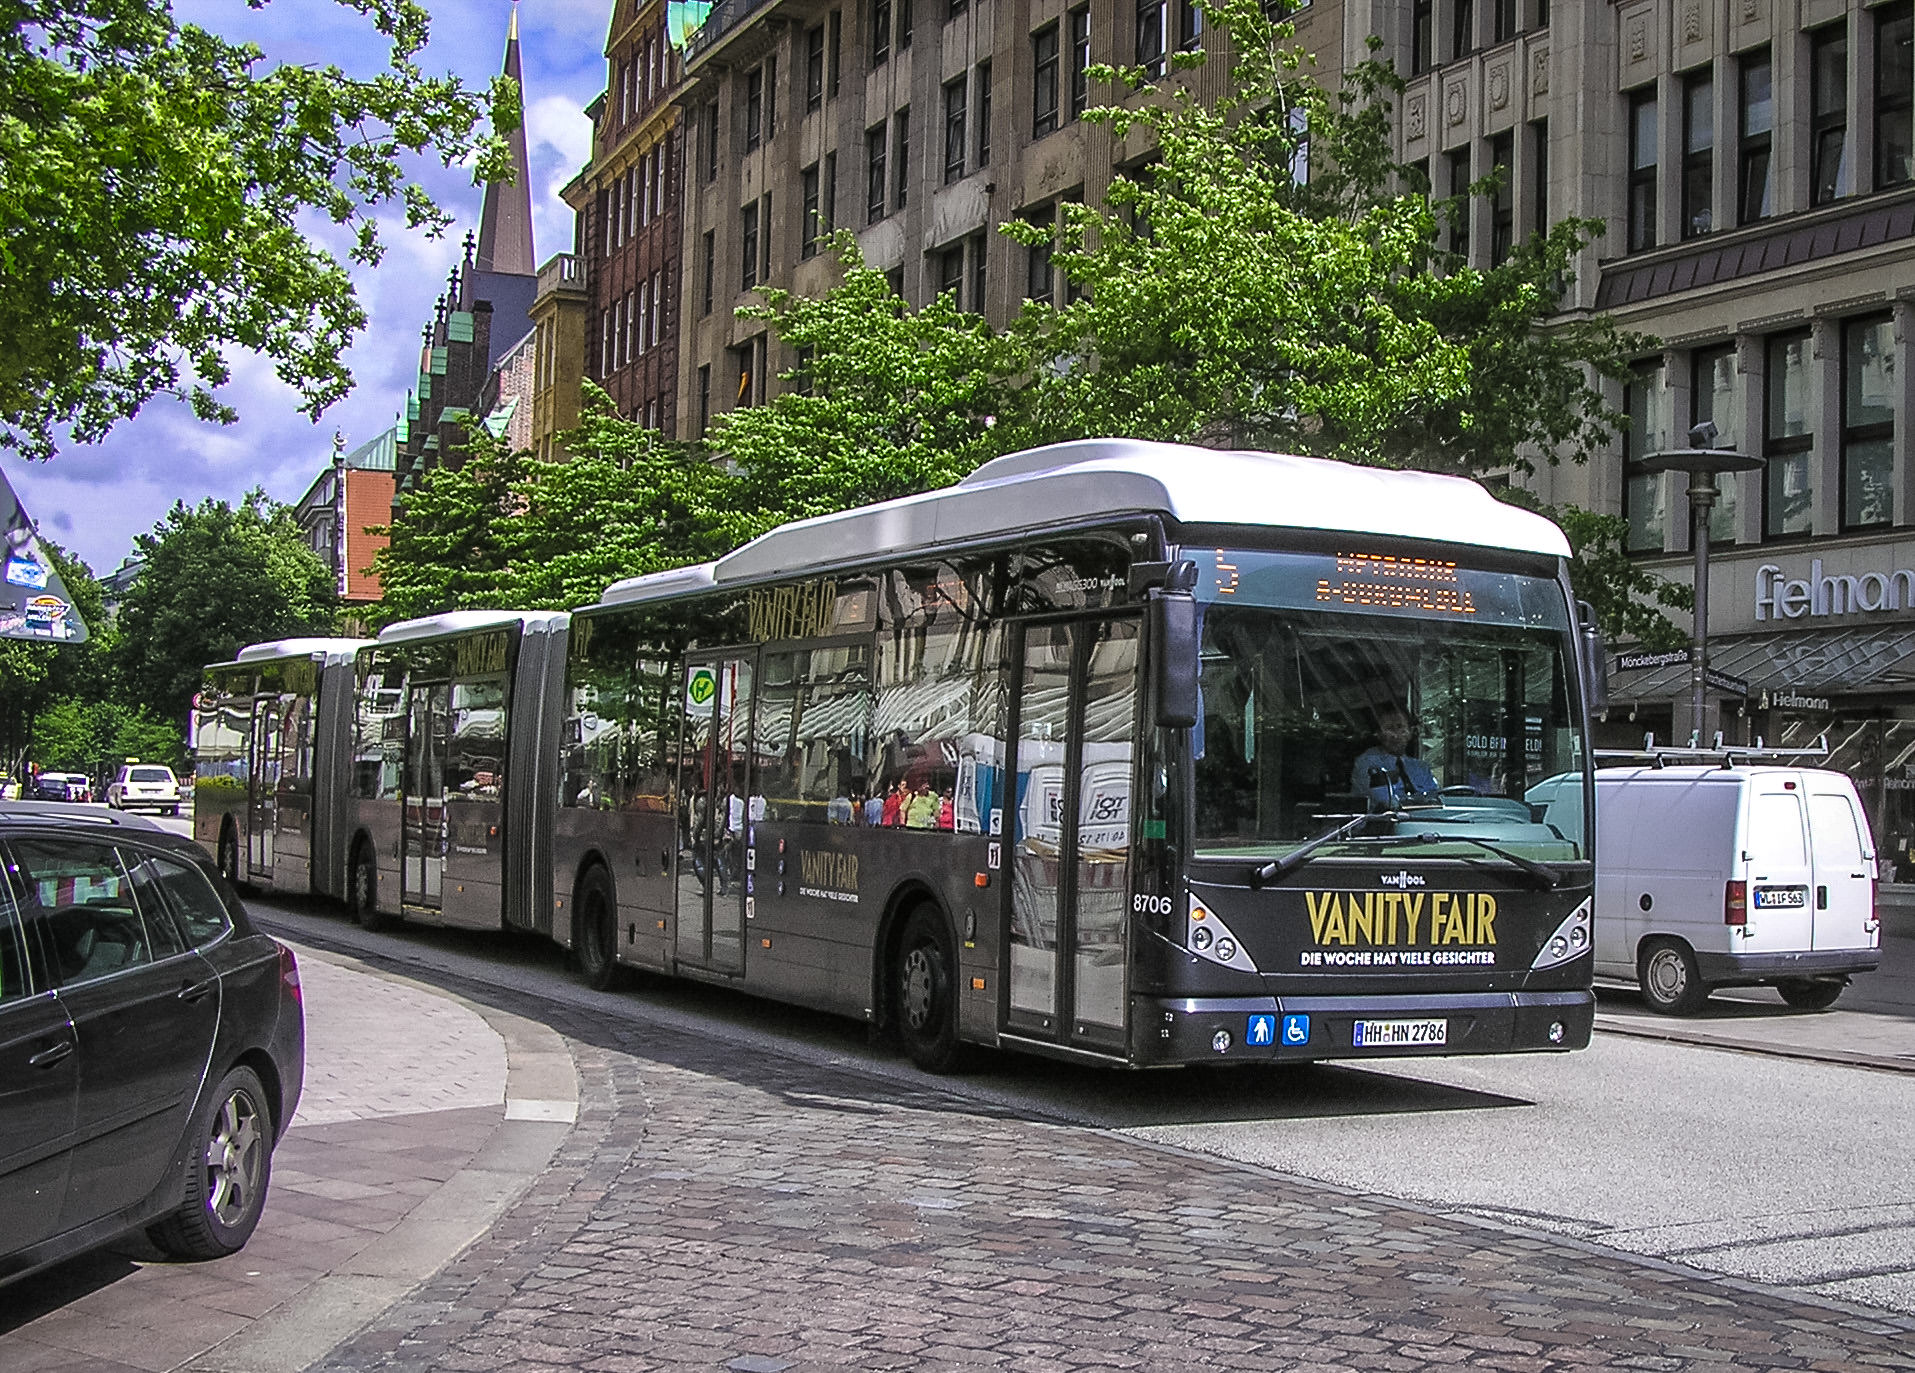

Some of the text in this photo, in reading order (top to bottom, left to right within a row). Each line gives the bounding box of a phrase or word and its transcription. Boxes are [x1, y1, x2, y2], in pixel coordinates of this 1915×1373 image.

[1215, 549, 1239, 593] 5
[1133, 893, 1172, 915] 8706
[1305, 891, 1498, 945] VANITY FAIR
[1301, 951, 1496, 966] DIE WOCHE HAT VIELE GESICHTER
[1364, 1022, 1445, 1042] HH HN 2786
